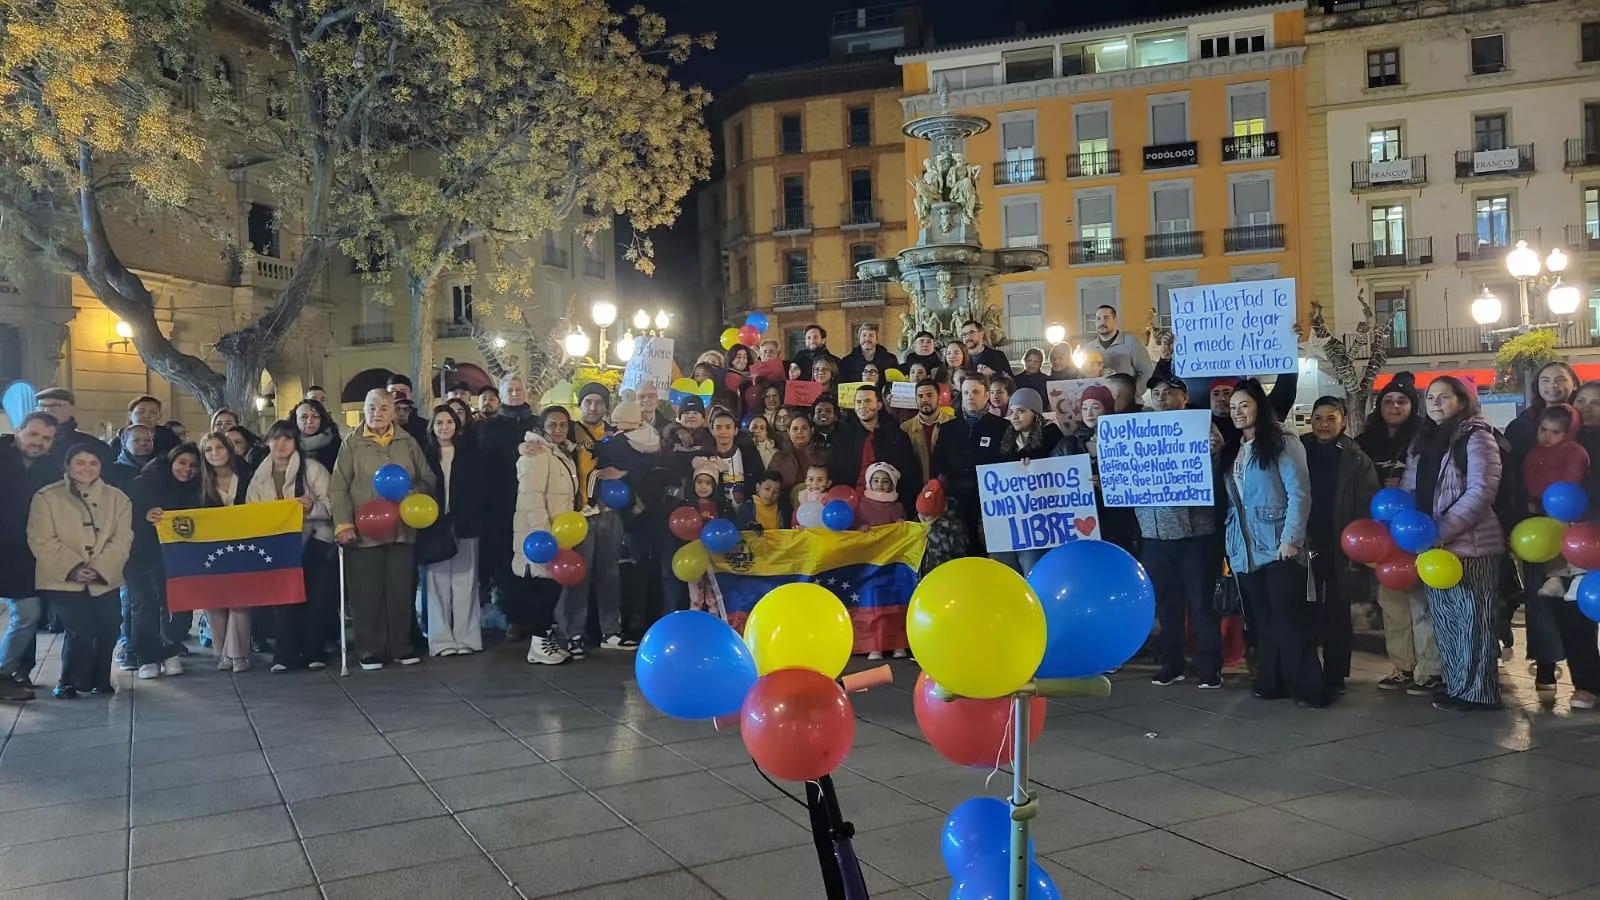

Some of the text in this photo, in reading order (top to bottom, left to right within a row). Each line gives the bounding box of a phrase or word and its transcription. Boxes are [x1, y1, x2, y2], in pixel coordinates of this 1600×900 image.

[1265, 140, 1276, 148] 16
[1146, 149, 1194, 160] PODÓLOGO
[1173, 292, 1194, 315] La
[1241, 310, 1282, 337] dejar
[1175, 335, 1188, 356] el
[1193, 334, 1235, 353] miedo
[1235, 355, 1245, 370] el
[1189, 440, 1209, 454] nos
[1182, 456, 1203, 470] nos
[1016, 488, 1094, 515] Venezuela
[1008, 512, 1079, 550] LIBRE
